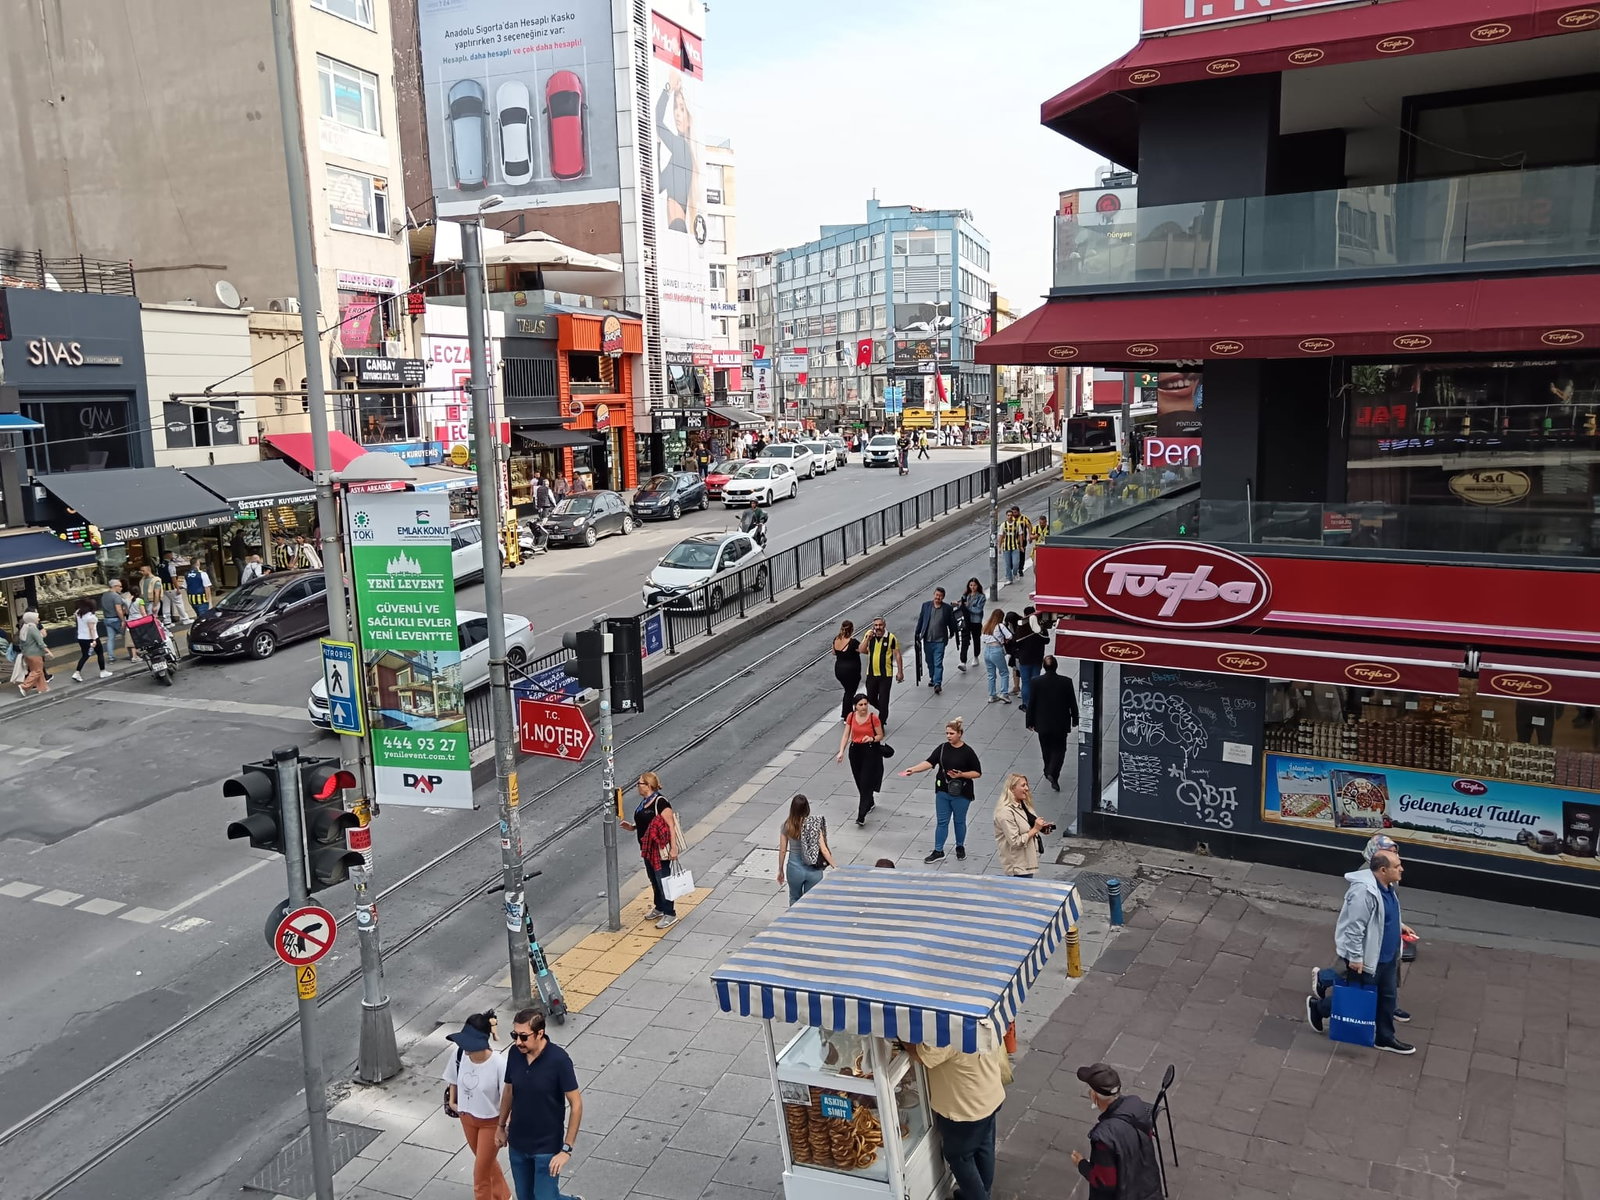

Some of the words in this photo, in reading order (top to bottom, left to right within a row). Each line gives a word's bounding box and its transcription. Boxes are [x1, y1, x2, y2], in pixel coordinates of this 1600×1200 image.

[444, 28, 474, 39] Anadolu
[476, 21, 519, 36] Sigorta'dan
[520, 16, 549, 28] Hesaplı
[551, 12, 575, 23] Kasko
[455, 36, 495, 50] yaptırırken
[497, 34, 502, 43] 3
[504, 28, 548, 42] seçeneğiniz
[470, 51, 486, 61] daha
[487, 48, 512, 60] hesaplı
[522, 44, 535, 55] çok
[536, 42, 553, 52] daha
[28, 337, 84, 366] SİVAS
[366, 359, 396, 371] CANBAY
[350, 486, 365, 494] ASYA
[115, 528, 139, 541] SİVAS
[144, 518, 198, 536] KUYUMCULUK
[367, 577, 395, 589] YENİ
[398, 579, 444, 589] LEVENT
[376, 602, 422, 614] GÜVENLİ
[425, 604, 440, 614] VE
[368, 615, 414, 627] SAĞLIKLI
[417, 618, 451, 628] EVLER
[369, 628, 393, 640] YENİ
[396, 631, 453, 641] LEVENT'TE
[544, 710, 560, 720] T.C.
[523, 722, 583, 748] 1.NOTER
[383, 736, 412, 750] 444
[418, 738, 435, 750] 93
[440, 739, 457, 752] 27
[384, 751, 456, 761] yenilevent.com.tr
[1400, 794, 1482, 819] Geleneksel
[1486, 805, 1540, 826] Tatlar
